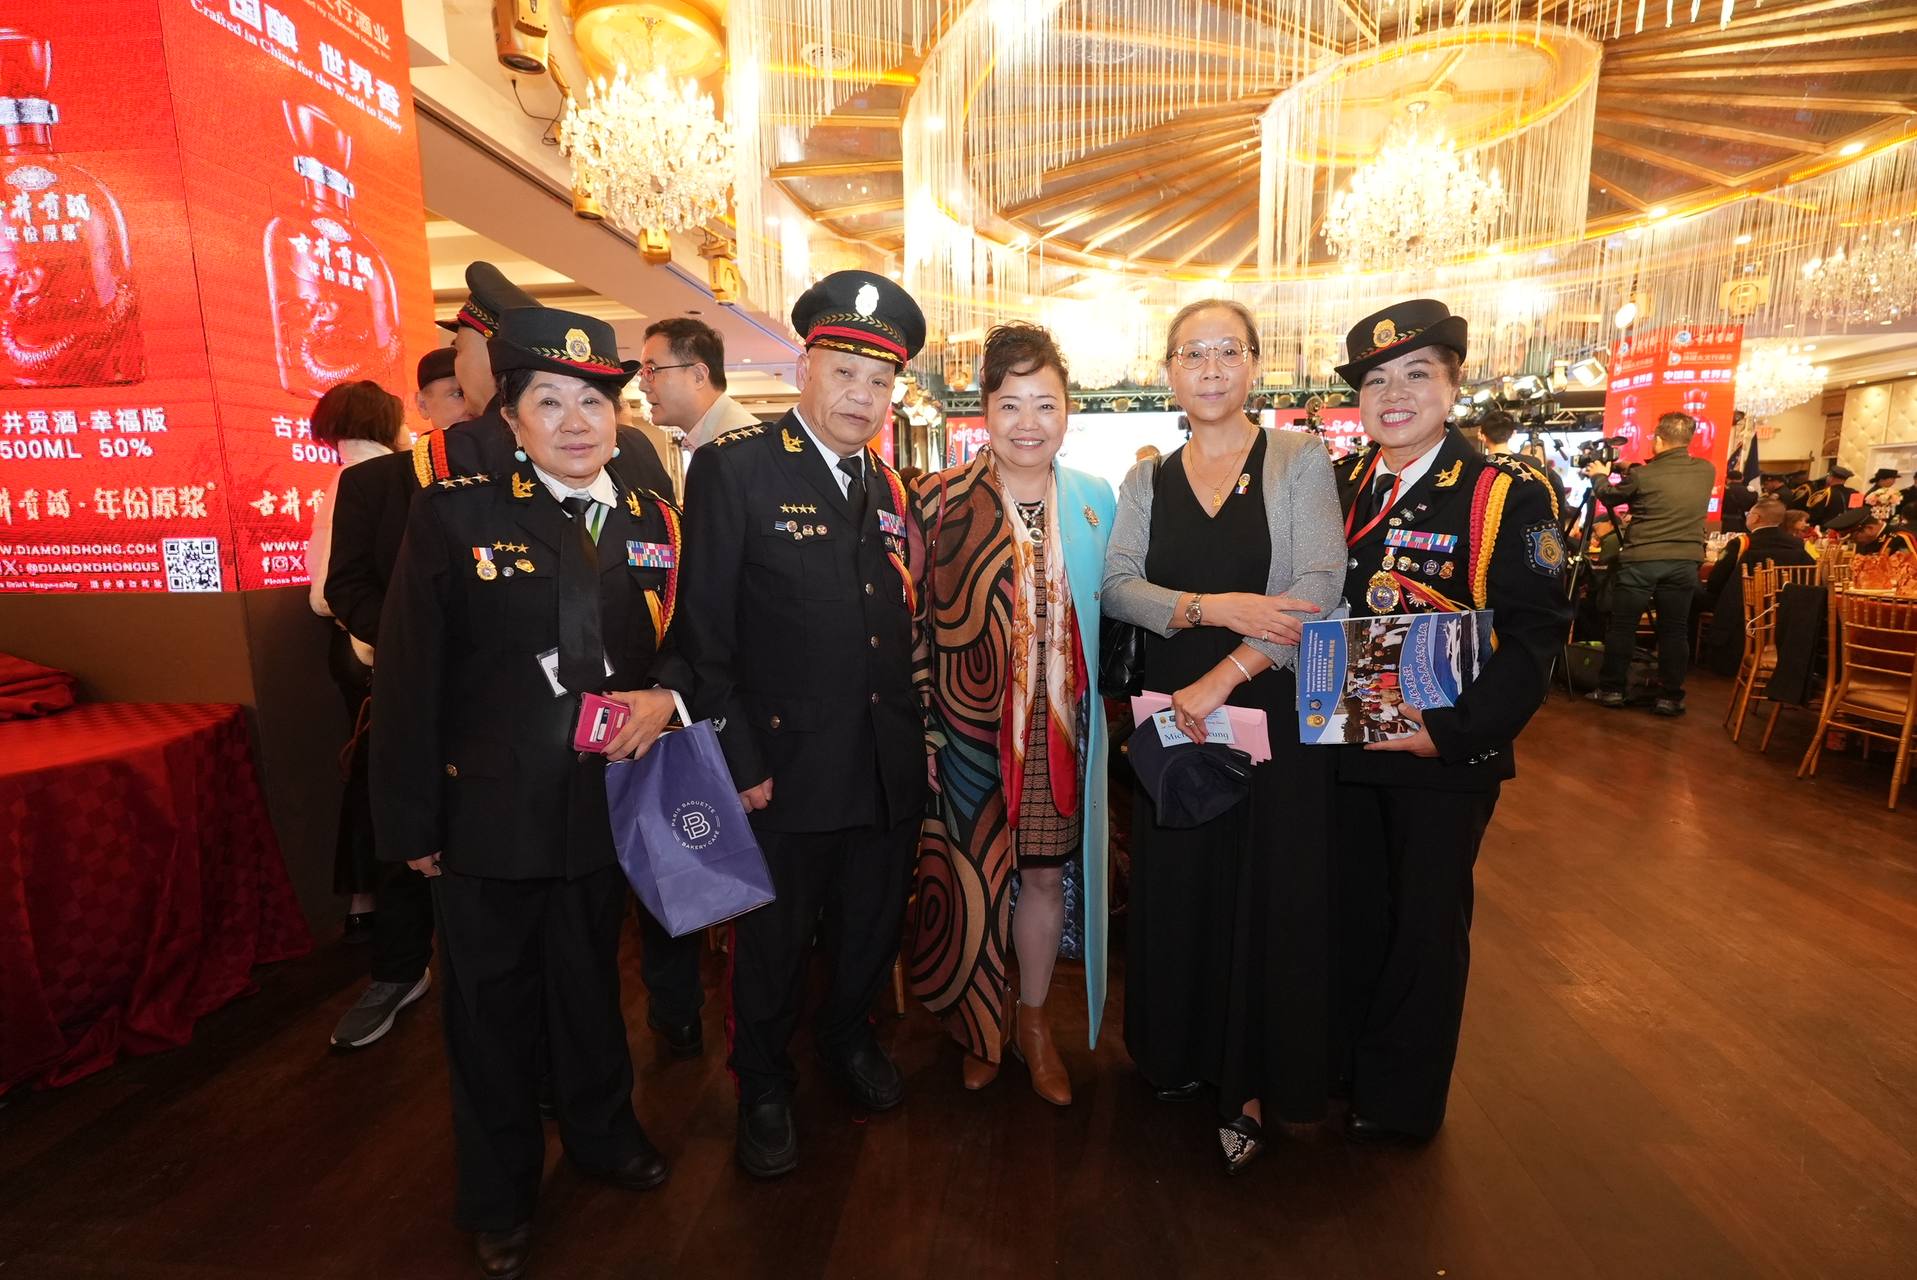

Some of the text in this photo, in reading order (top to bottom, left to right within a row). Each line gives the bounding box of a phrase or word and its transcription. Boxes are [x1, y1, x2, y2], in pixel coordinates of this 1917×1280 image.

[190, 0, 241, 37] Crafted
[244, 28, 258, 46] in
[259, 38, 297, 69] China
[296, 60, 314, 79] for
[315, 72, 333, 91] the
[333, 82, 366, 112] World
[377, 109, 402, 134] Enjoy
[318, 41, 401, 118] 世界香
[0, 438, 154, 459] 500ML 50%
[671, 800, 716, 827] PARIS BAGUETTE
[681, 841, 707, 850] BAKERY
